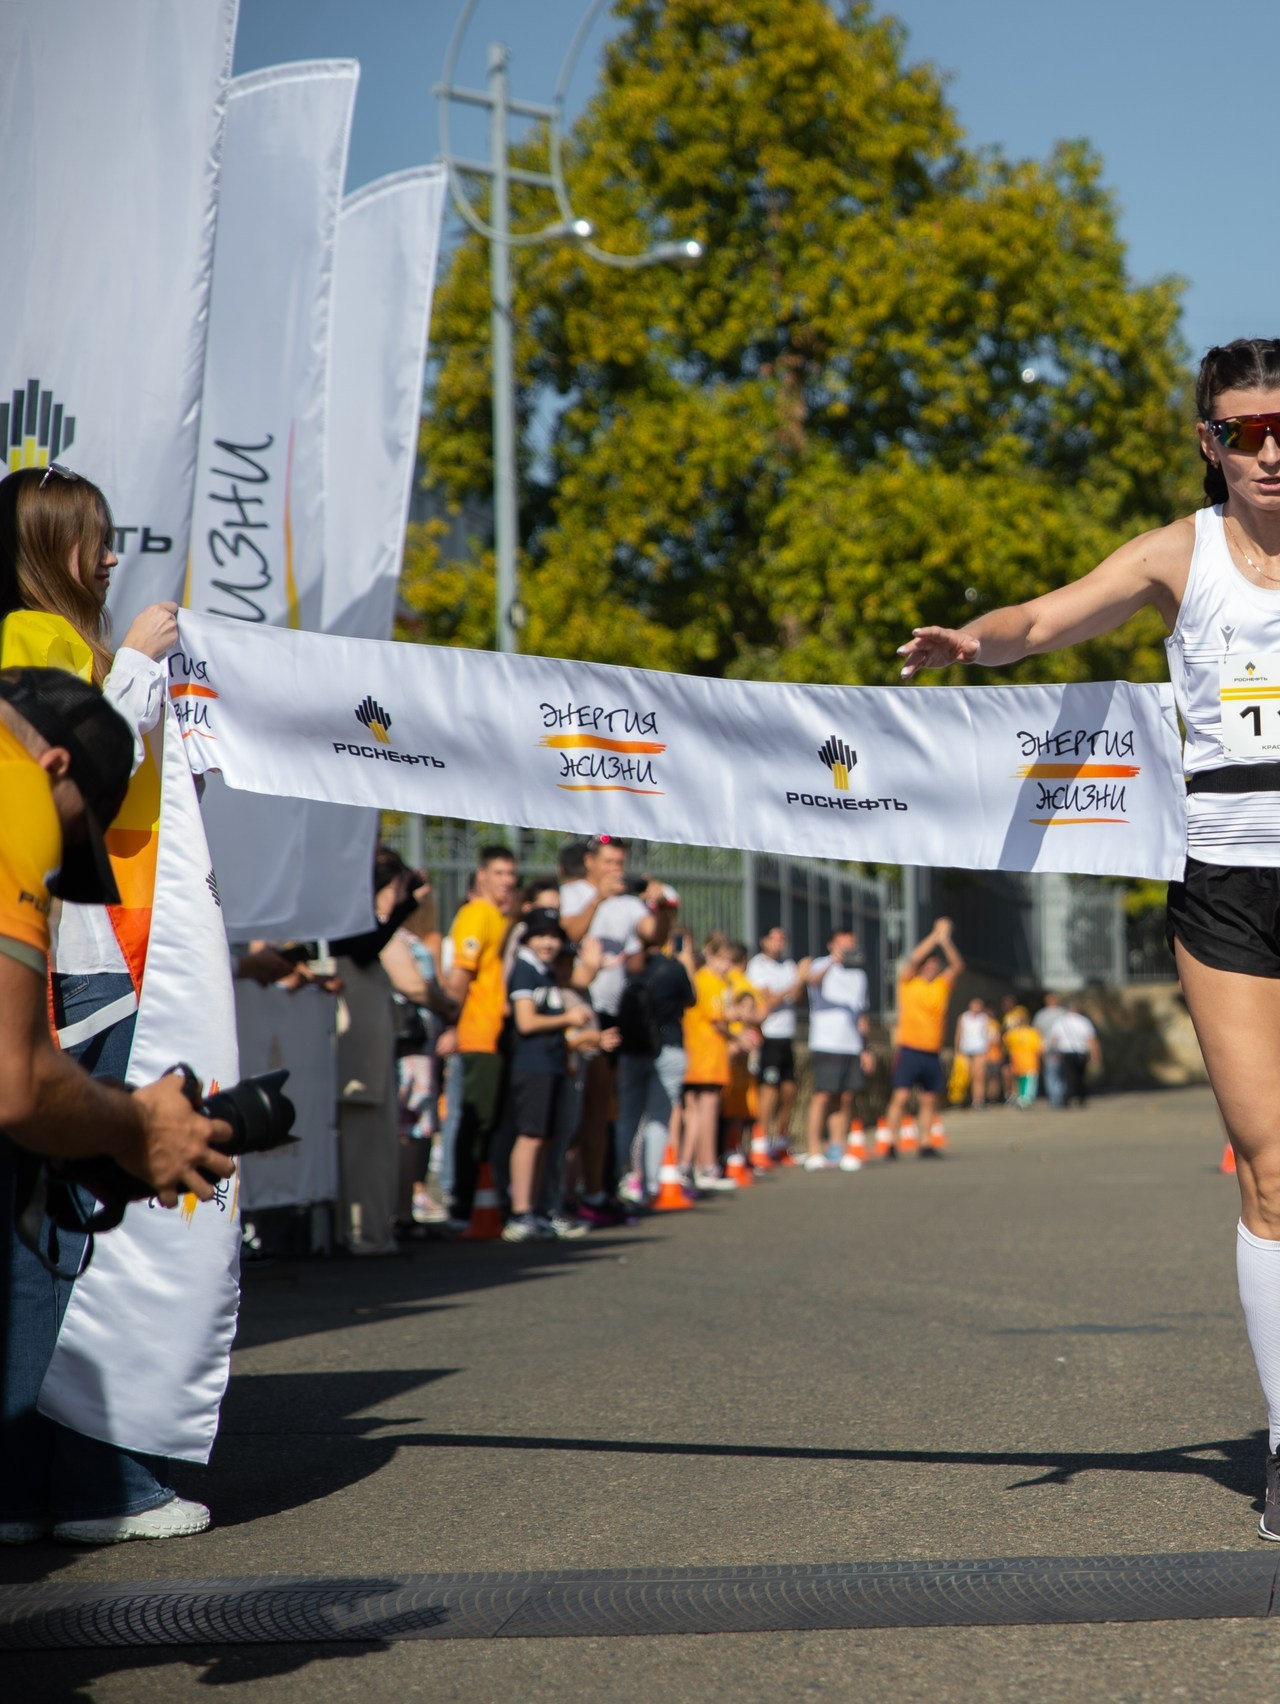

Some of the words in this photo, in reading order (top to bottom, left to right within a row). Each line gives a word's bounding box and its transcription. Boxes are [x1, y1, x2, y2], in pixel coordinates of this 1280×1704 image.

[207, 433, 275, 624] ИЗНИ
[539, 702, 659, 735] ЭНЕРГИЯ
[332, 742, 446, 769] РОСНЕФТЬ
[1016, 730, 1135, 757] ЭНЕРГИЯ
[559, 752, 658, 785] ЖИЗНИ
[786, 791, 909, 812] РОСНЕФТЬ
[1035, 783, 1128, 813] ЖИЗНИ
